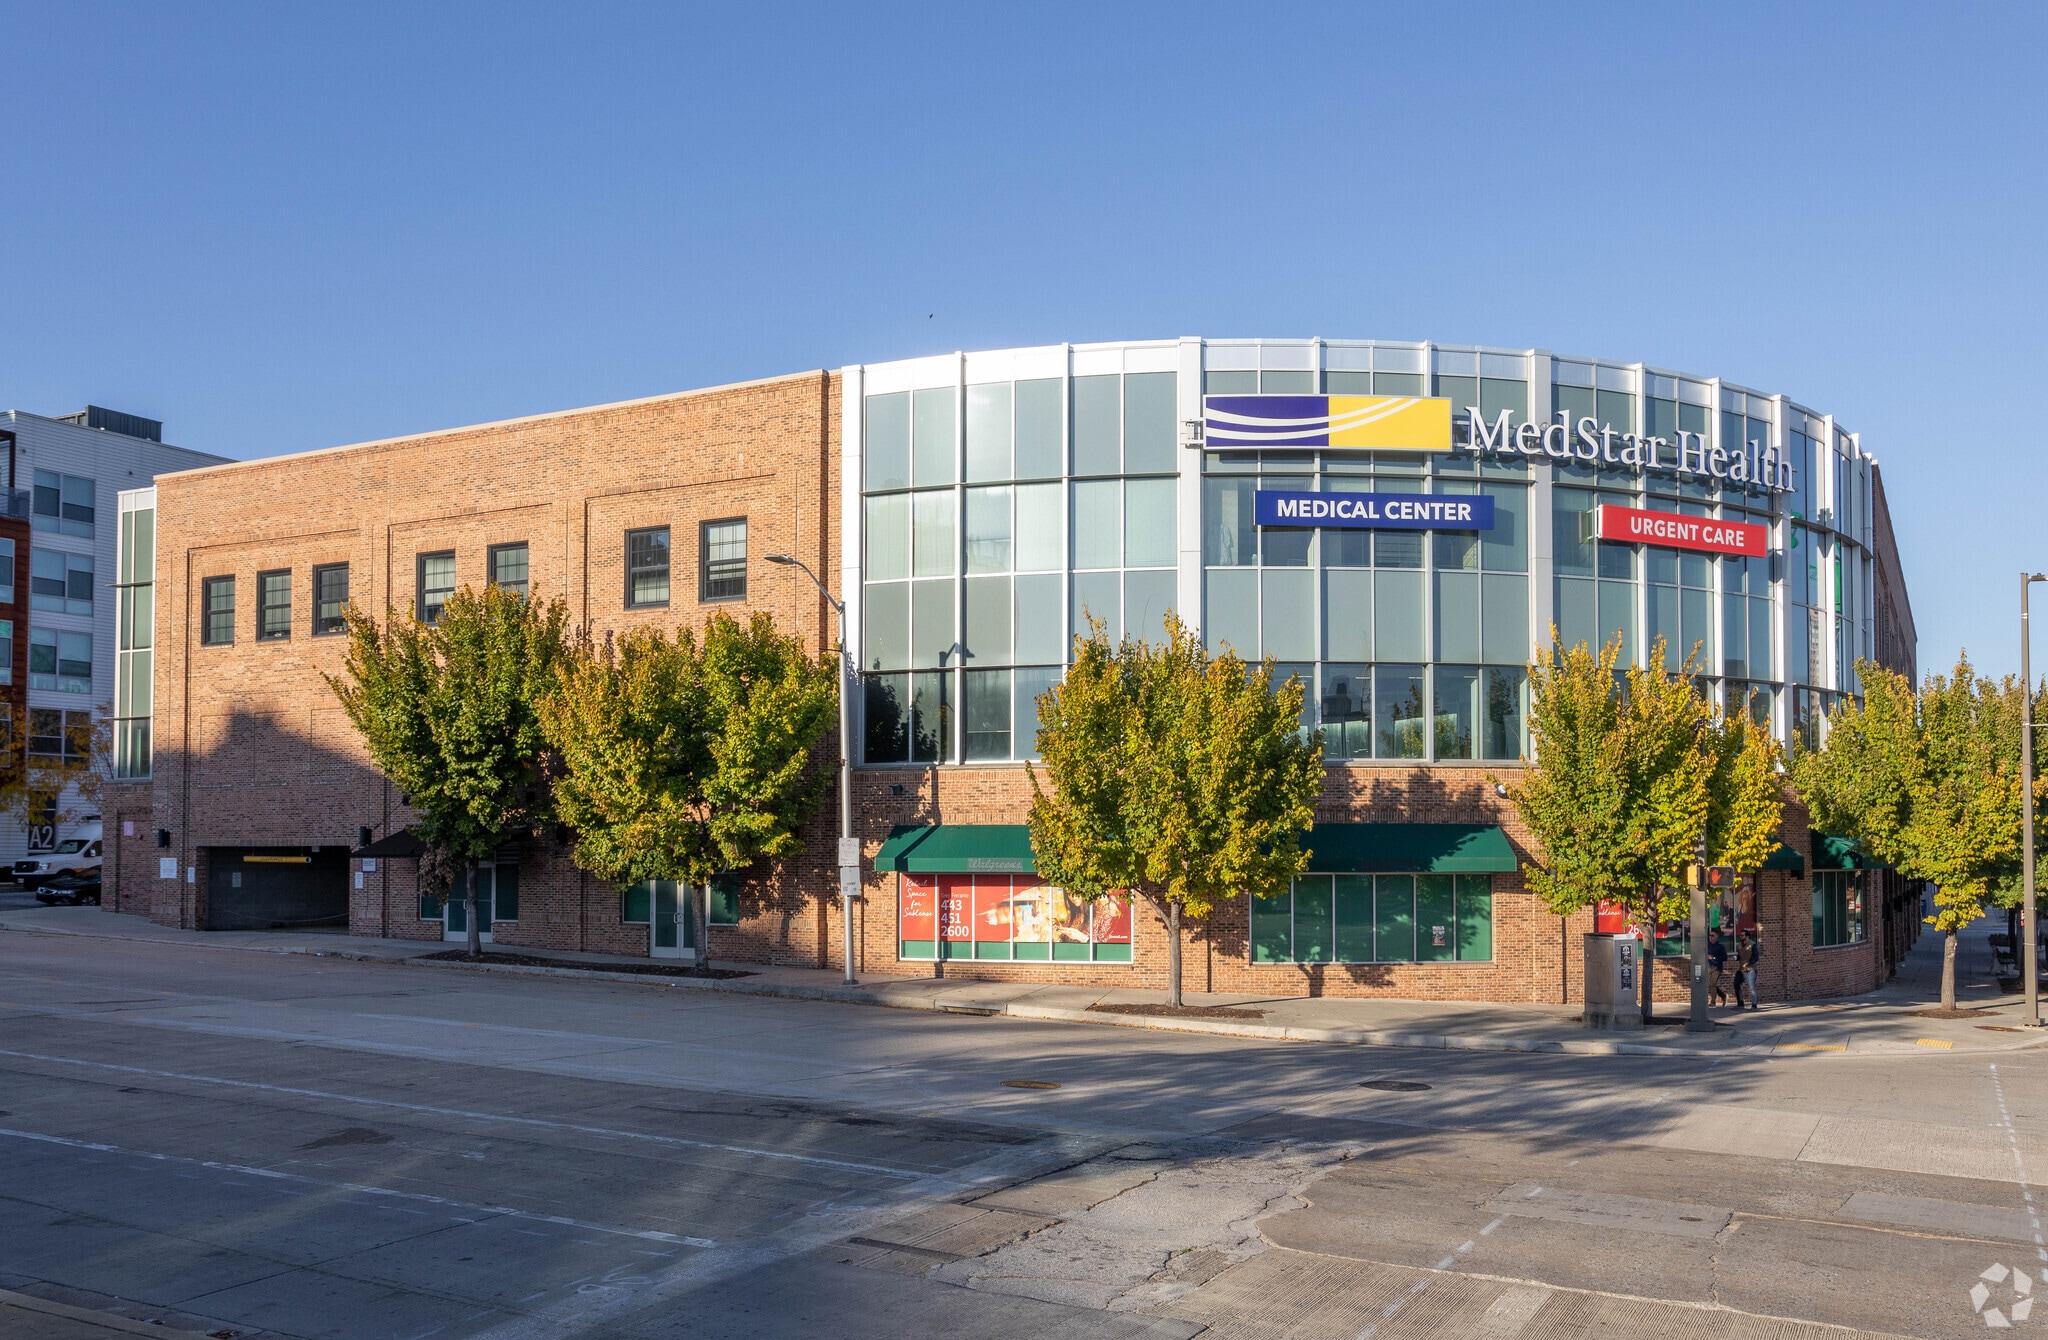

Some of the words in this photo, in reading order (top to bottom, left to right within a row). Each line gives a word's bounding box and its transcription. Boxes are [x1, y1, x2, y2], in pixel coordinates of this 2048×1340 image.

[1464, 405, 1667, 469] MedStar
[1674, 429, 1795, 493] Health
[1277, 499, 1380, 519] MEDICAL
[1384, 501, 1472, 521] CENTER
[1630, 516, 1699, 542] URGENT
[1702, 526, 1745, 547] CARE
[29, 825, 54, 849] A2
[968, 858, 1022, 871] Walgreens
[906, 888, 927, 898] Space
[911, 900, 922, 909] for
[941, 900, 962, 910] 443
[903, 908, 933, 917] Sublease
[941, 913, 961, 923] 451
[941, 926, 969, 936] 2600
